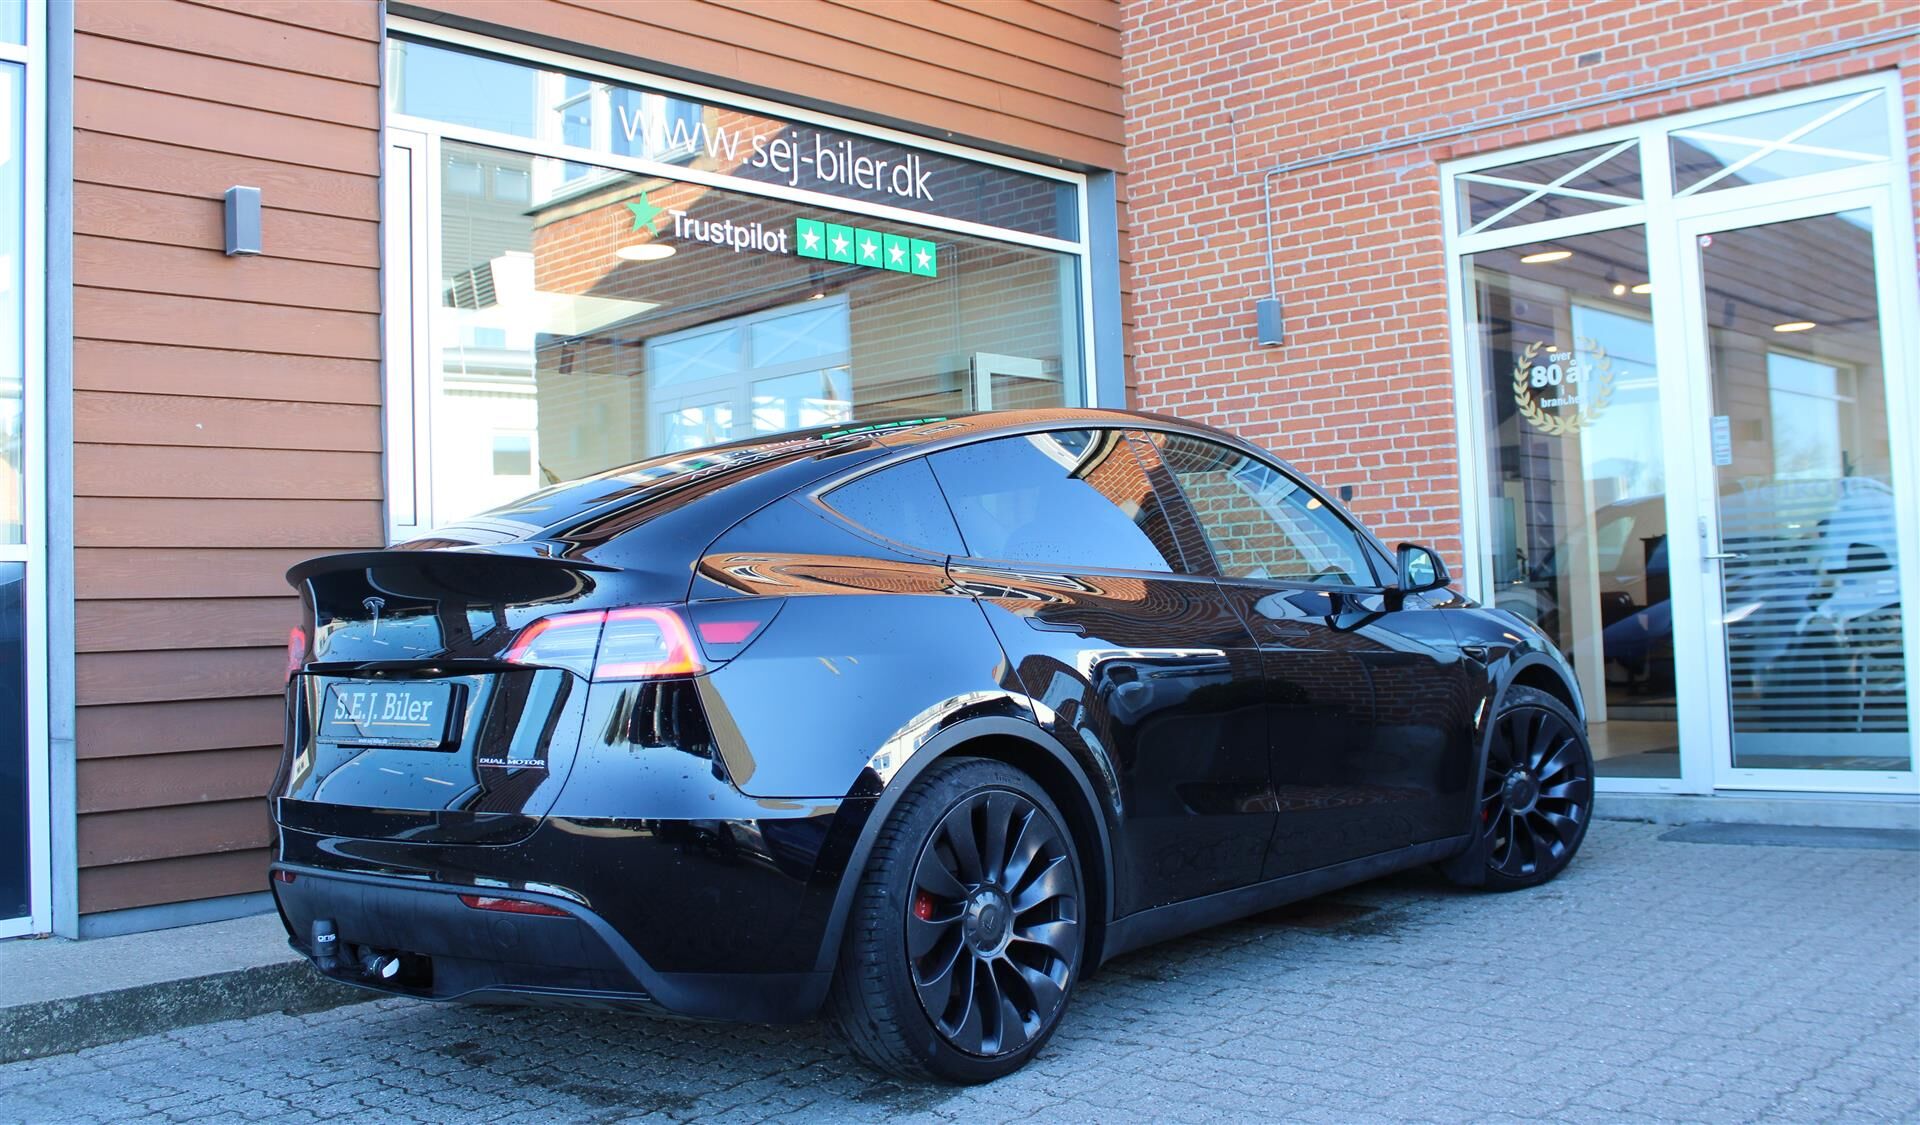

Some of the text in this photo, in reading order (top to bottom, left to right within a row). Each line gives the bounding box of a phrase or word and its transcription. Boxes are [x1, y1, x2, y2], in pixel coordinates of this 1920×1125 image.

[618, 105, 934, 201] www.sej-biler.dk
[669, 209, 788, 253] Trustpilot
[1549, 351, 1572, 363] over
[1531, 359, 1593, 388] 80 år
[1541, 393, 1589, 408] branche
[334, 692, 433, 728] S.E.J. Biler
[479, 757, 506, 765] DUAL
